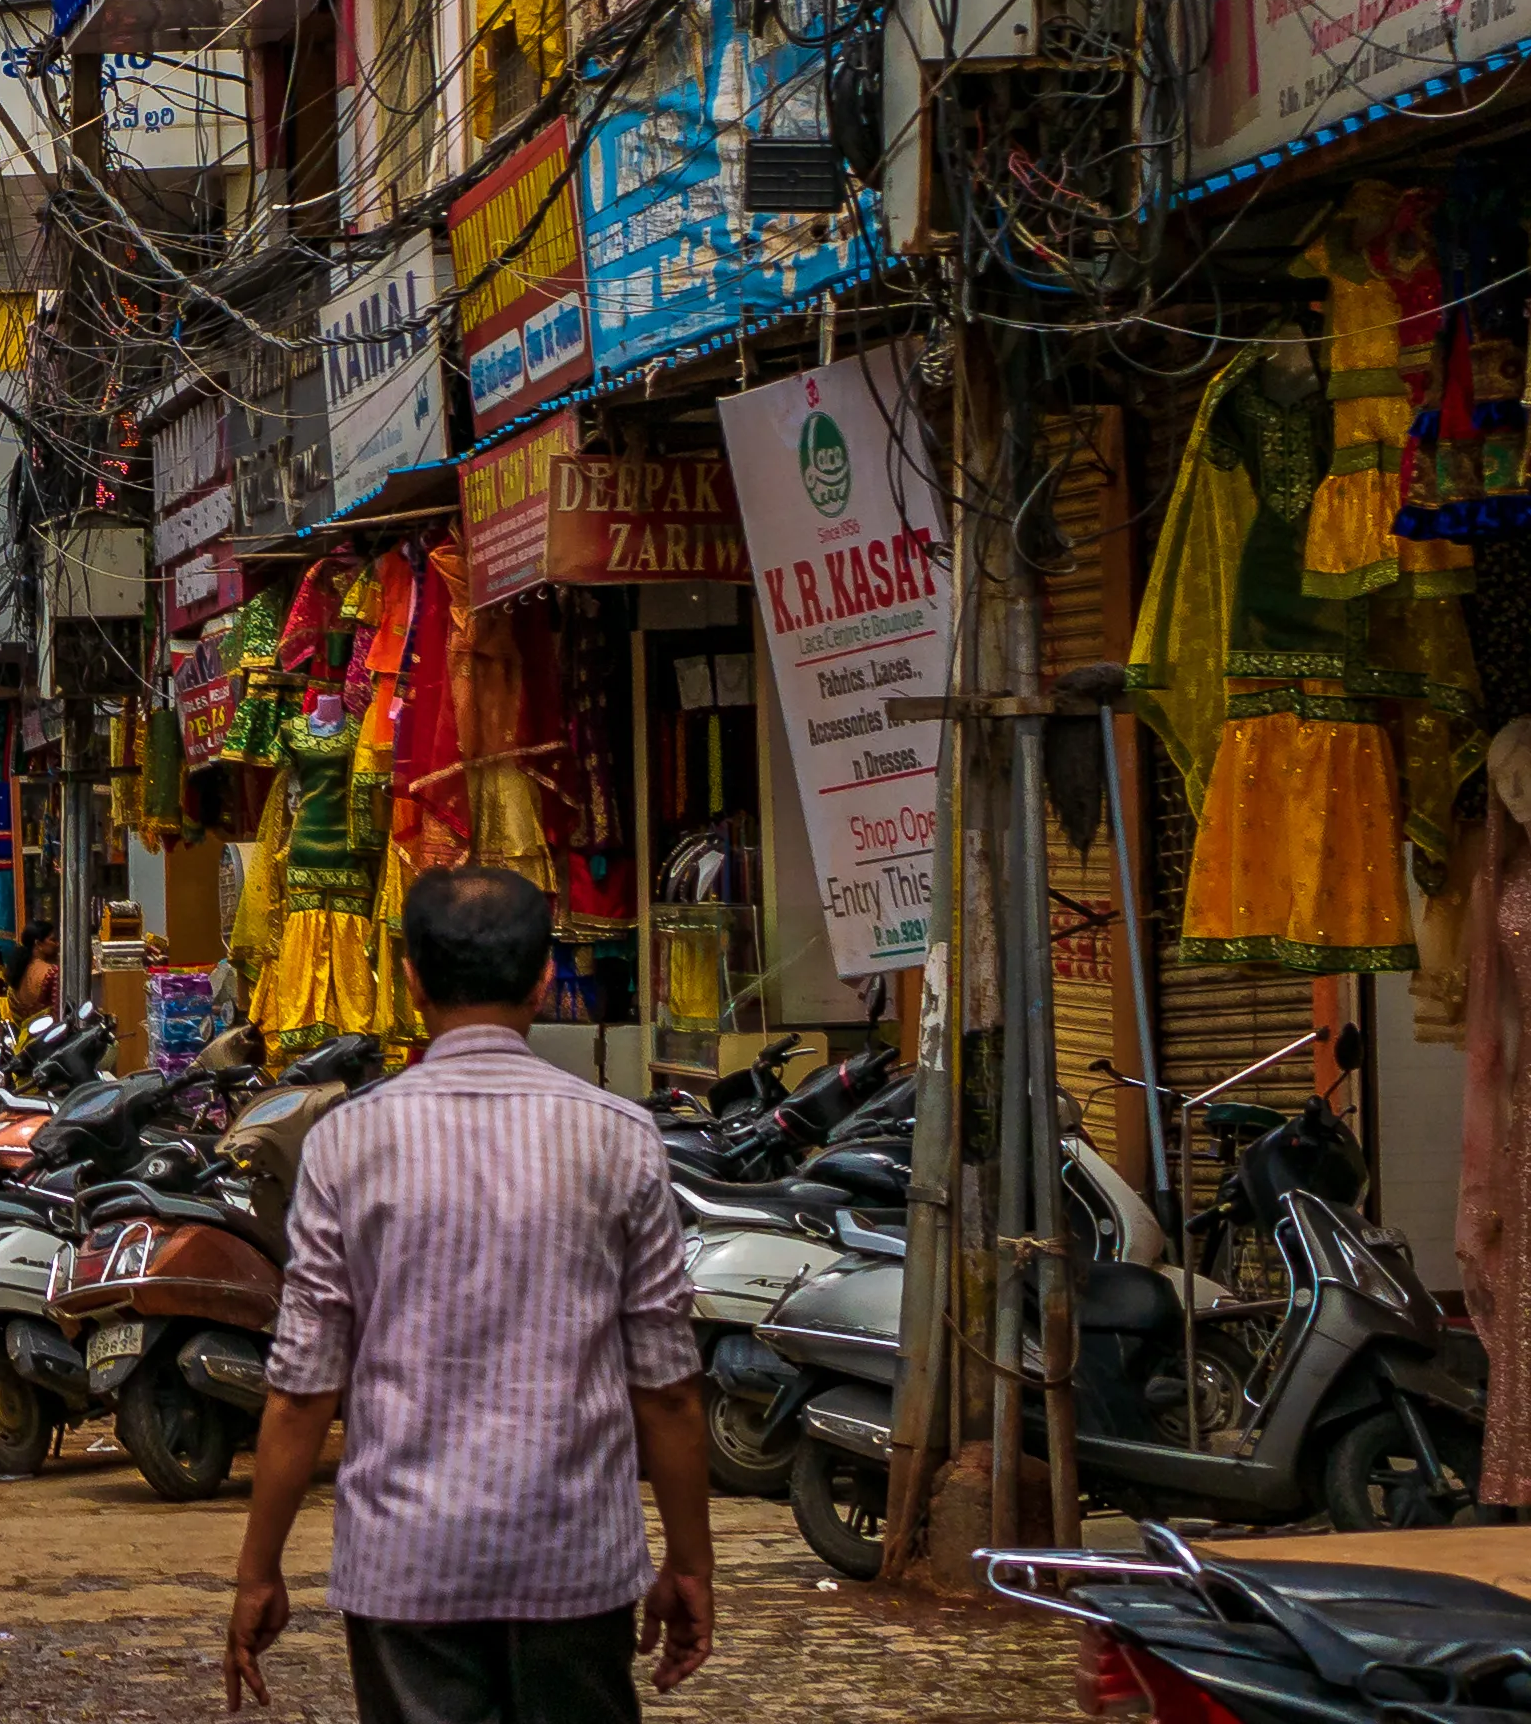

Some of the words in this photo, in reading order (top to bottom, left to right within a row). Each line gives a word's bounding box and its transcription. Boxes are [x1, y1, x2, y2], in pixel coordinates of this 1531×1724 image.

[326, 270, 428, 407] KAMAL
[557, 463, 722, 512] DEEPAK
[607, 523, 751, 572] ZARIW
[796, 632, 825, 656] Lace
[824, 626, 859, 650] Centre
[807, 706, 884, 746] Accessories
[850, 815, 899, 854] Shop
[900, 806, 936, 847] Ope
[826, 876, 882, 921] Entry
[882, 864, 932, 908] This
